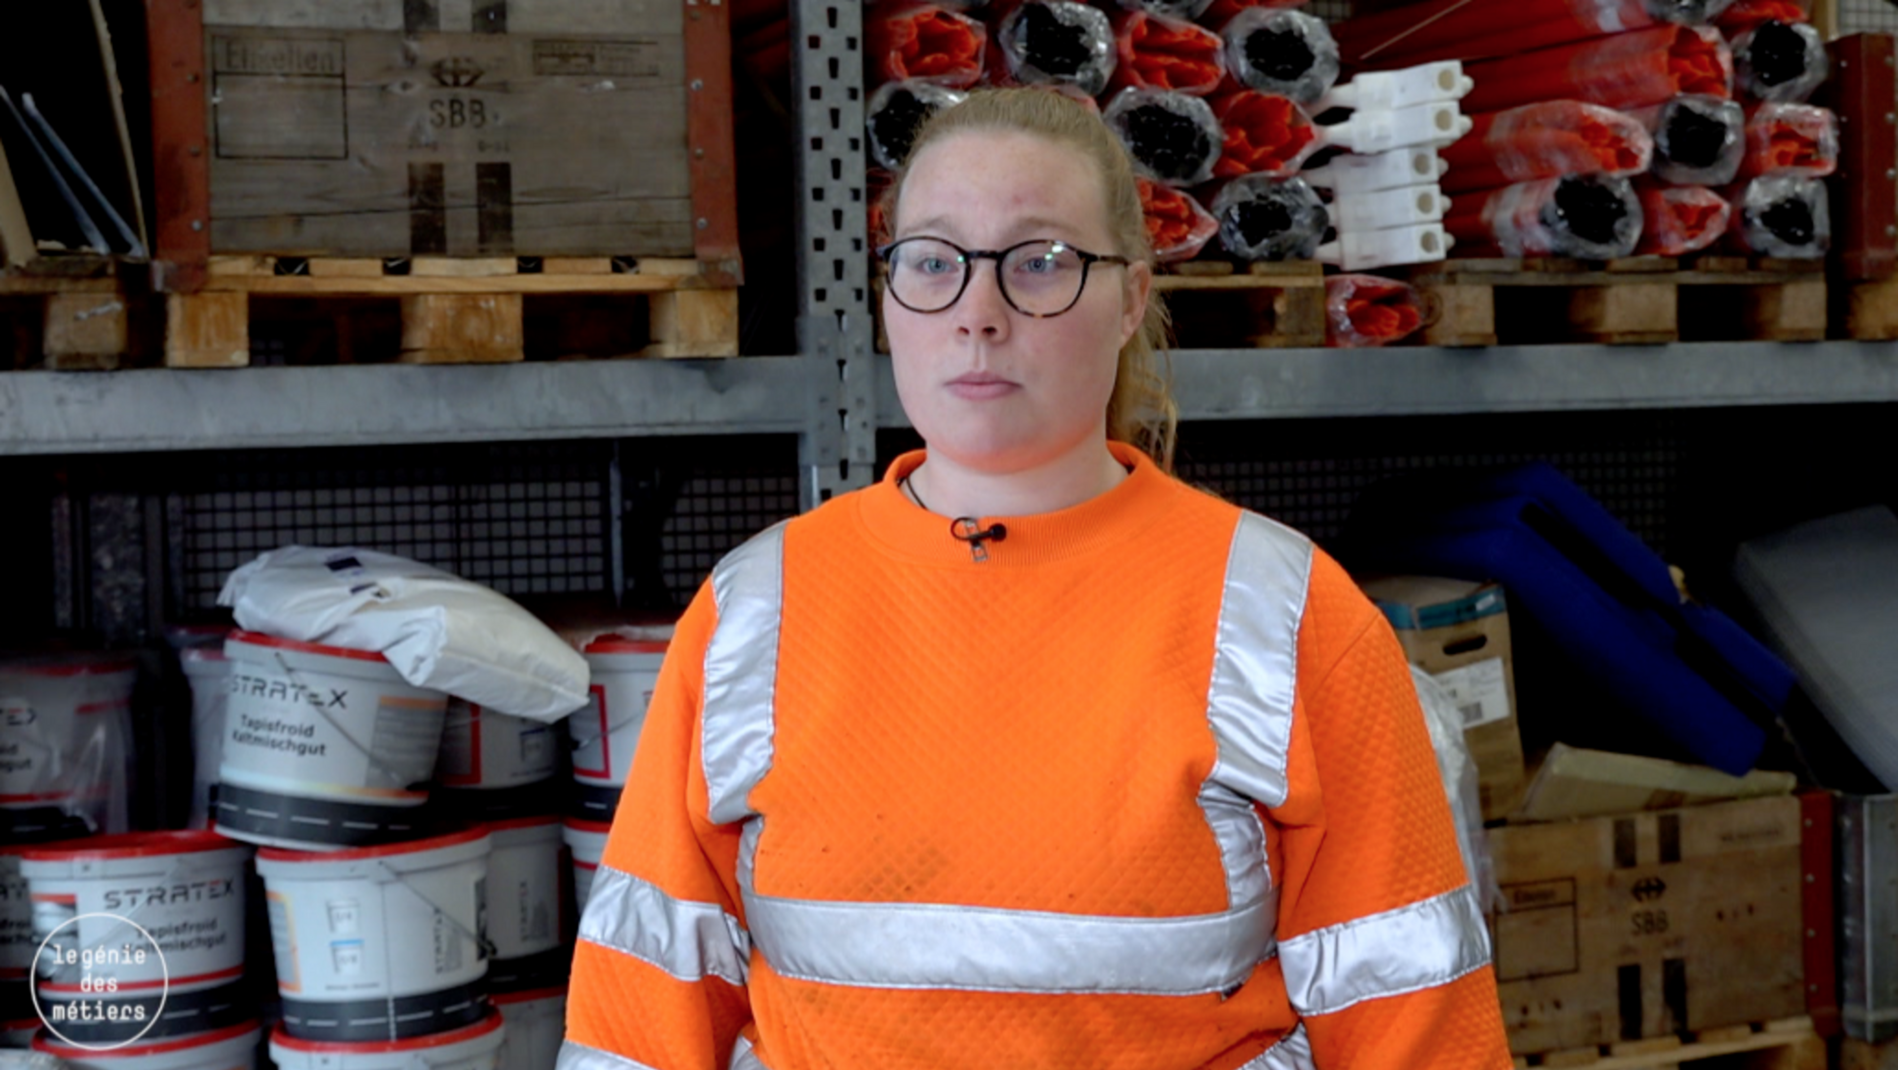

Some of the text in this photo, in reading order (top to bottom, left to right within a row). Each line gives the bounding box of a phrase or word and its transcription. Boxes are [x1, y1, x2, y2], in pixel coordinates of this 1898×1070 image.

[428, 98, 487, 129] SBB
[231, 674, 348, 710] STRATEX
[241, 713, 315, 738] Tapisfroid
[104, 878, 235, 909] STRATEX
[1631, 911, 1670, 936] SBB
